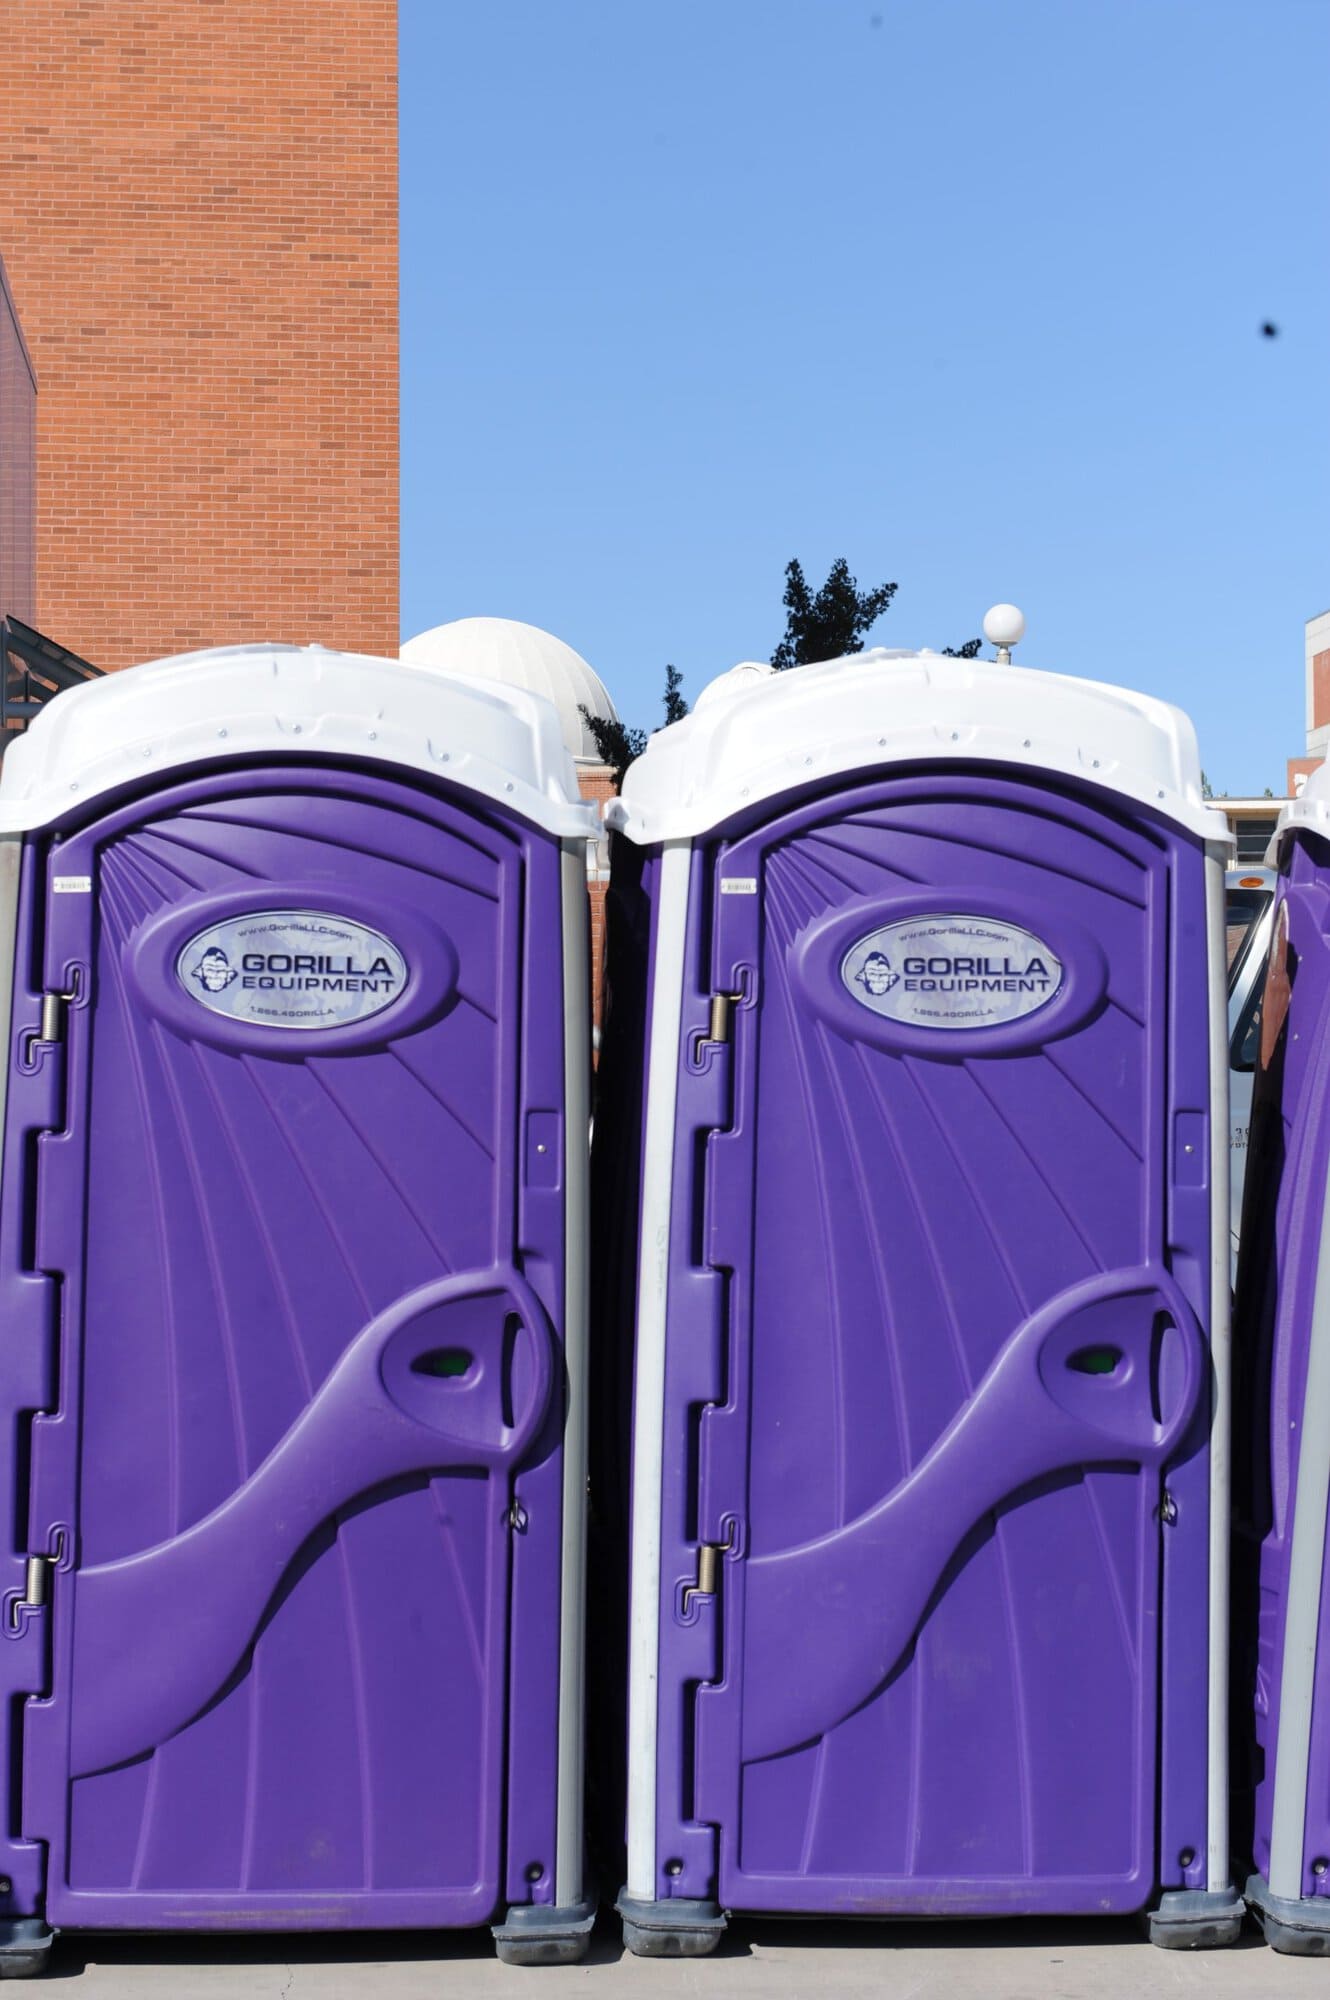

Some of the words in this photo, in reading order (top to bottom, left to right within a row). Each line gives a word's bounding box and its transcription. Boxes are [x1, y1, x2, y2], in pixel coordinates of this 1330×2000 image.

[238, 923, 353, 940] www.GorillaLLC.com
[898, 927, 1009, 942] www.GorillaLLC.com
[241, 953, 393, 976] GORILLA
[903, 957, 1049, 976] GORILLA
[242, 976, 395, 993] EQUIPMENT
[904, 978, 1050, 993] EQUIPMENT
